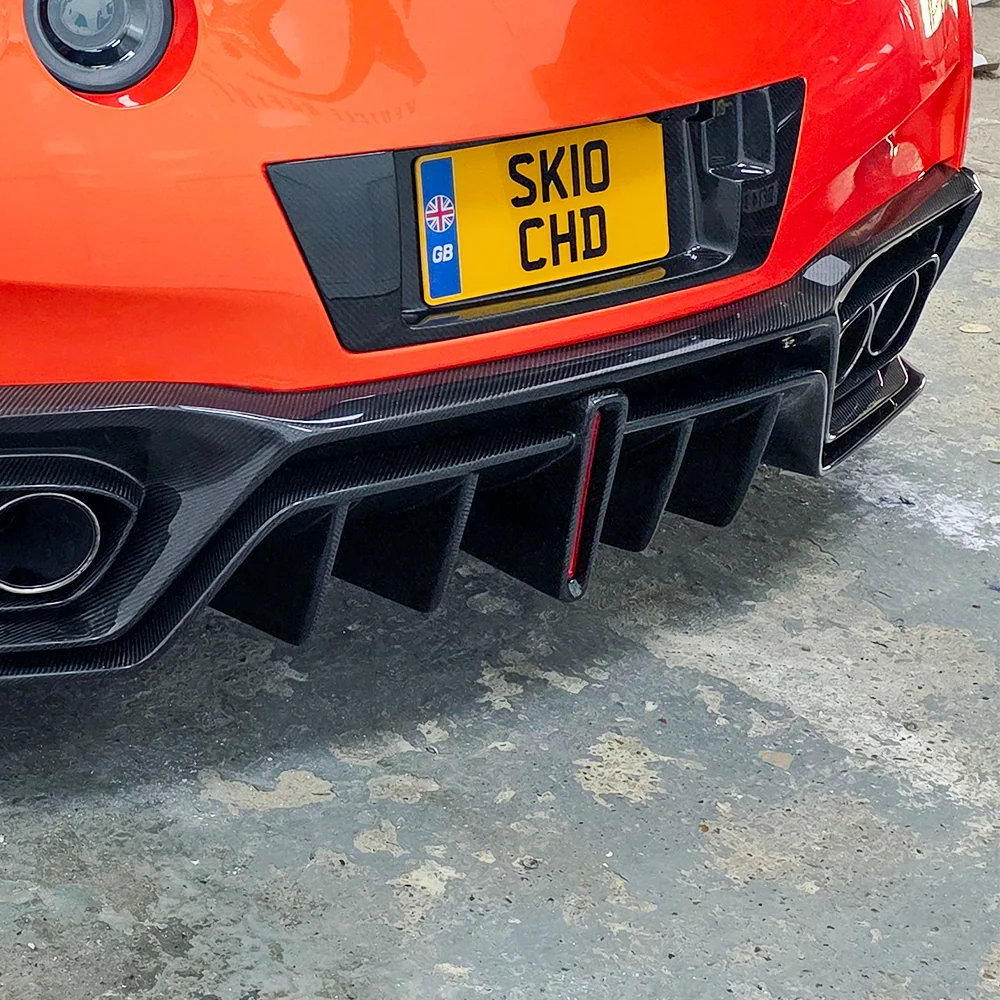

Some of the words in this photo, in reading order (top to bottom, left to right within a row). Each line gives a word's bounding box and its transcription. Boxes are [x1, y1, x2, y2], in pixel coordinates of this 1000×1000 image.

[508, 139, 610, 208] SK10
[432, 243, 454, 264] GB
[518, 205, 608, 271] CHD
